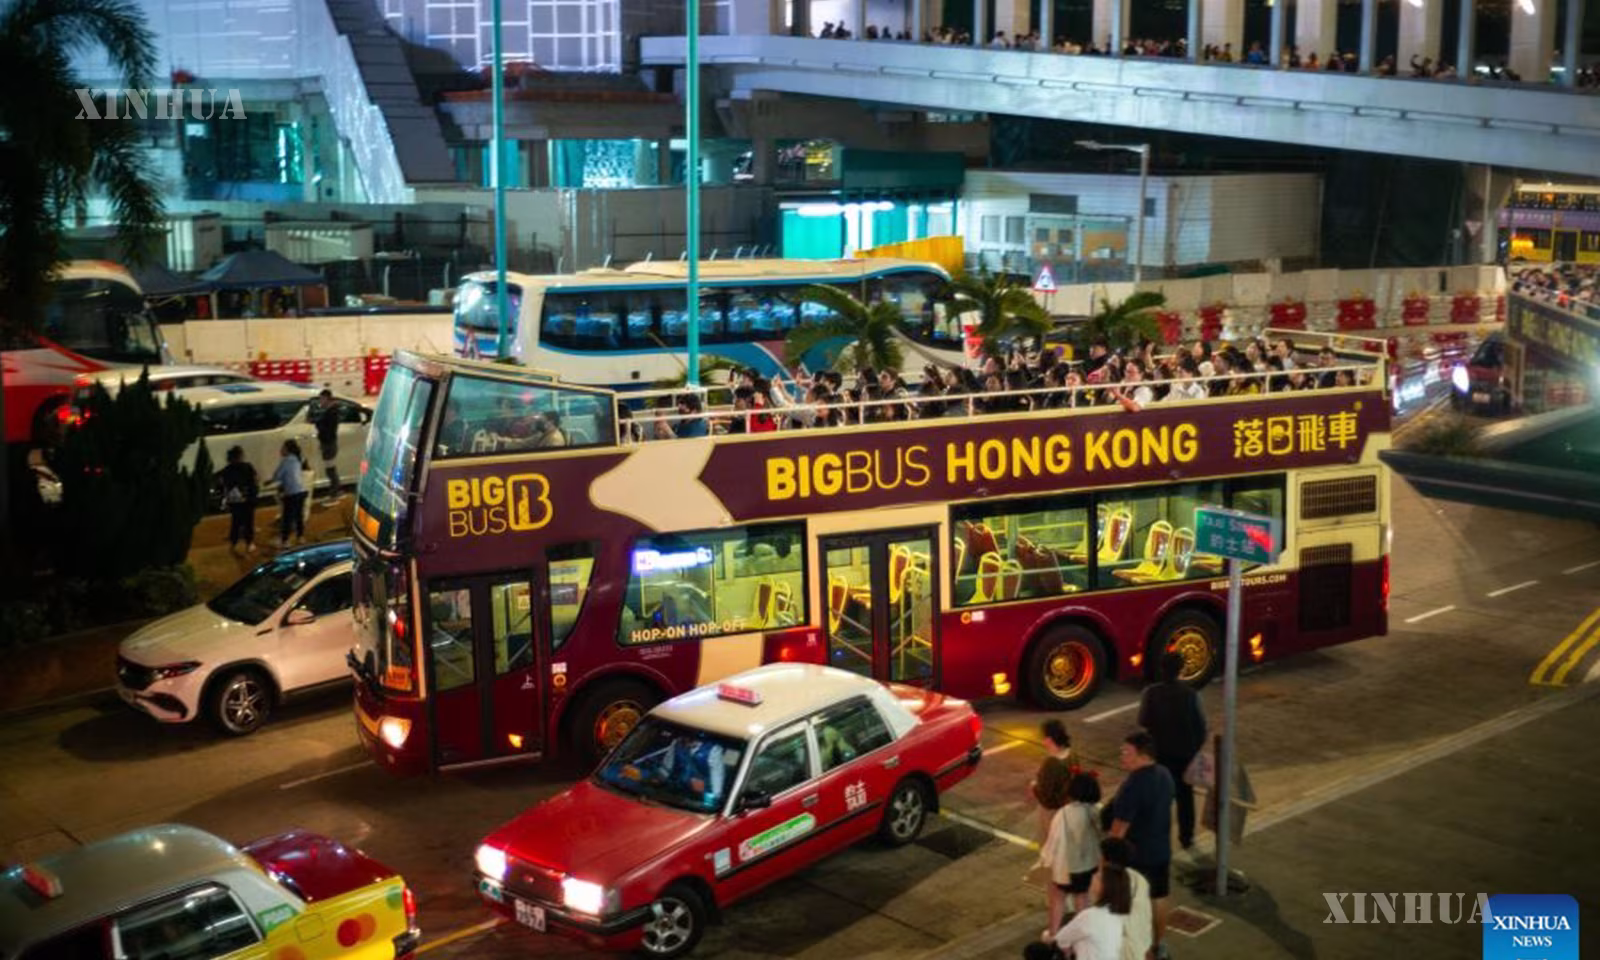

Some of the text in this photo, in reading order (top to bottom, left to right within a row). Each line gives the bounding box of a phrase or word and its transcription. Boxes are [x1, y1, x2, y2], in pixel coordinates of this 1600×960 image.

[946, 433, 1071, 483] HONG
[1085, 423, 1198, 471] KONG
[447, 476, 505, 509] BIG
[449, 506, 507, 537] BUS
[632, 626, 686, 642] HOP-ON
